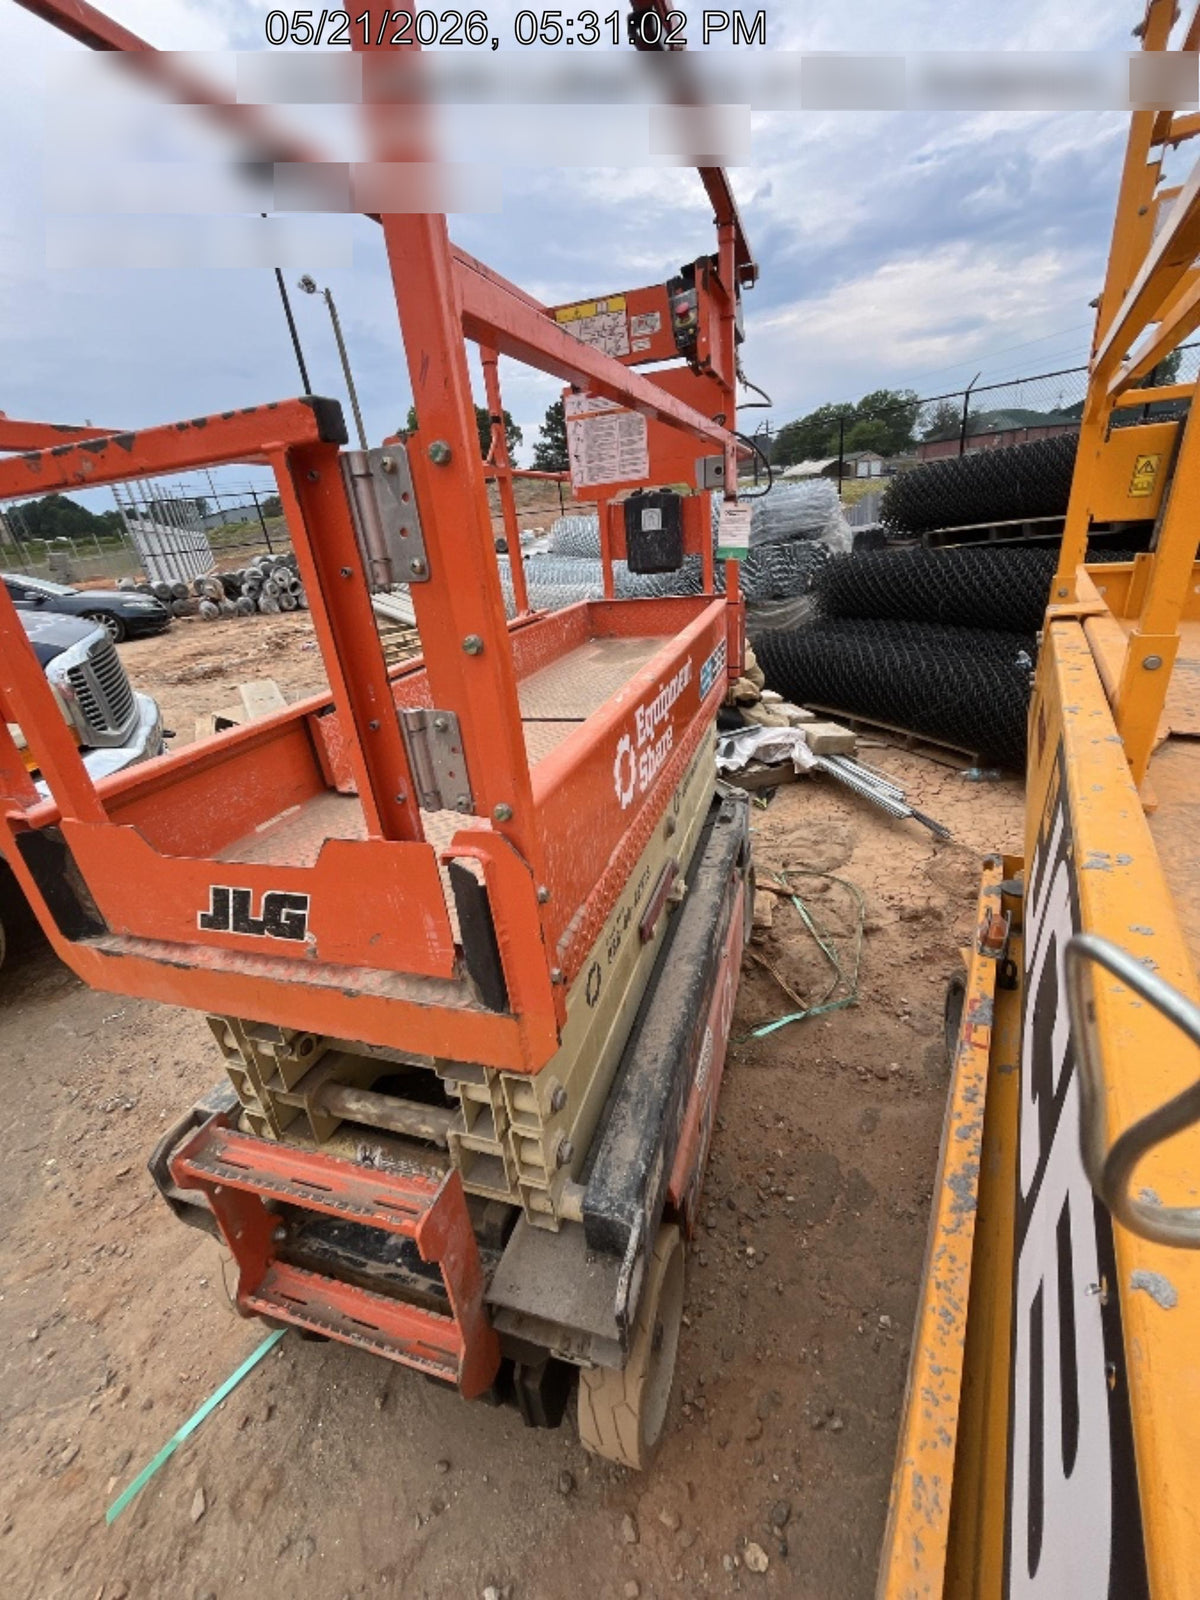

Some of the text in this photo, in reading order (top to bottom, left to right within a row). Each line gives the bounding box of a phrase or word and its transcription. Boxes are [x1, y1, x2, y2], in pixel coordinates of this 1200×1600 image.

[634, 655, 692, 748] Equipment
[639, 725, 673, 793] Share
[197, 885, 311, 942] JLG
